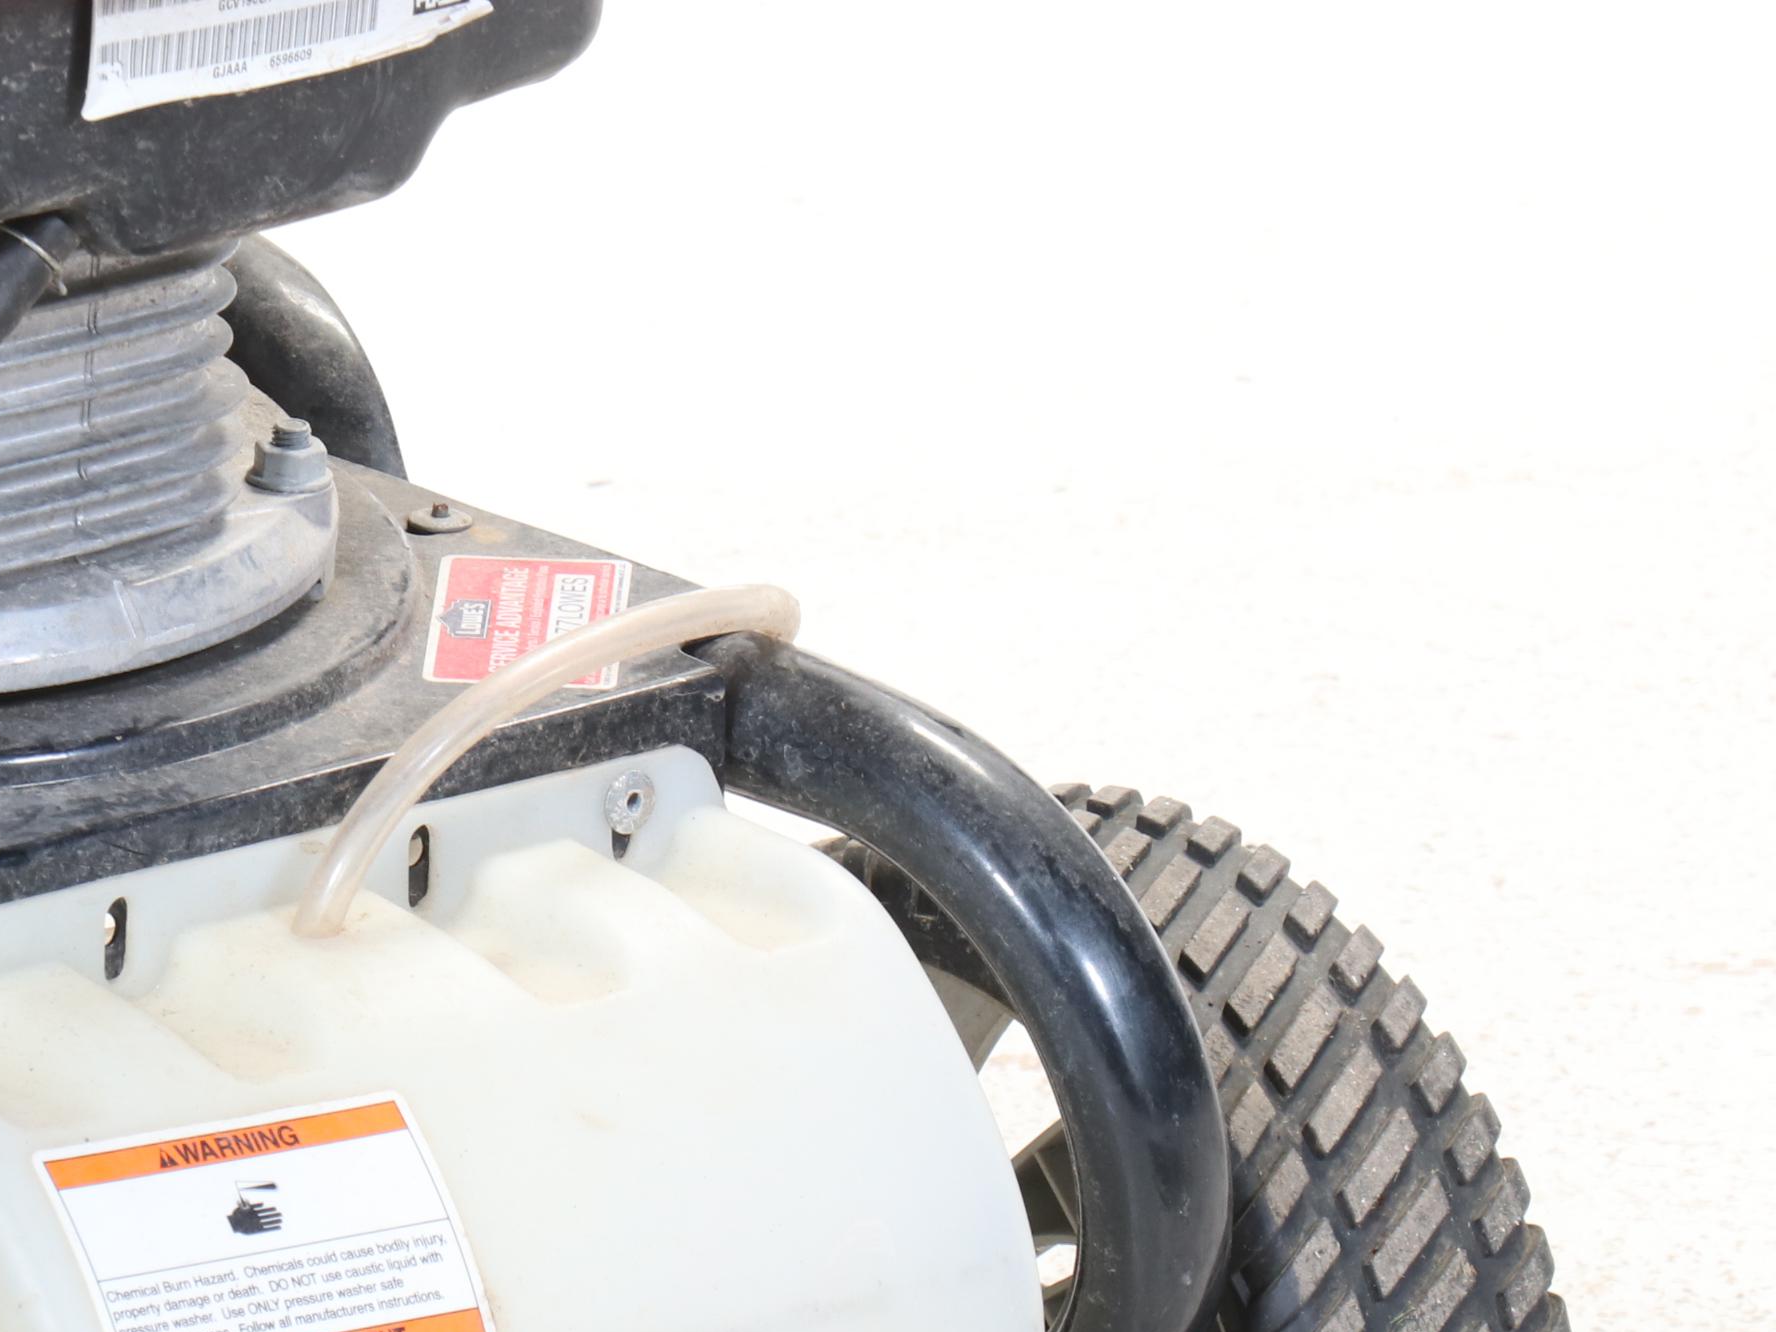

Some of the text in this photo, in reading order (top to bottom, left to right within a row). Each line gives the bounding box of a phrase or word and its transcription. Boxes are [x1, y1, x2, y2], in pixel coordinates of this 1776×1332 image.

[213, 61, 248, 79] GJAAA
[496, 568, 529, 628] ADVANTAGE
[174, 1125, 300, 1165] WARNING
[106, 1282, 160, 1303] Chemical
[162, 1279, 192, 1293] Burn
[193, 1269, 239, 1287] Hazard.
[243, 1258, 305, 1279] Chemicals
[306, 1251, 338, 1268] could
[340, 1246, 375, 1260] cause
[376, 1238, 410, 1255] bodily
[113, 1250, 443, 1322] property damage or death. DO NOT use caustic liquid with
[171, 1313, 216, 1329] washer.
[221, 1307, 246, 1320] Use
[248, 1299, 280, 1315] ONLY
[284, 1291, 334, 1311] pressure
[336, 1282, 377, 1299] washer
[380, 1277, 404, 1291] safe
[279, 1315, 292, 1329] all
[295, 1303, 375, 1326] manufacturers
[378, 1289, 444, 1310] instructions.
